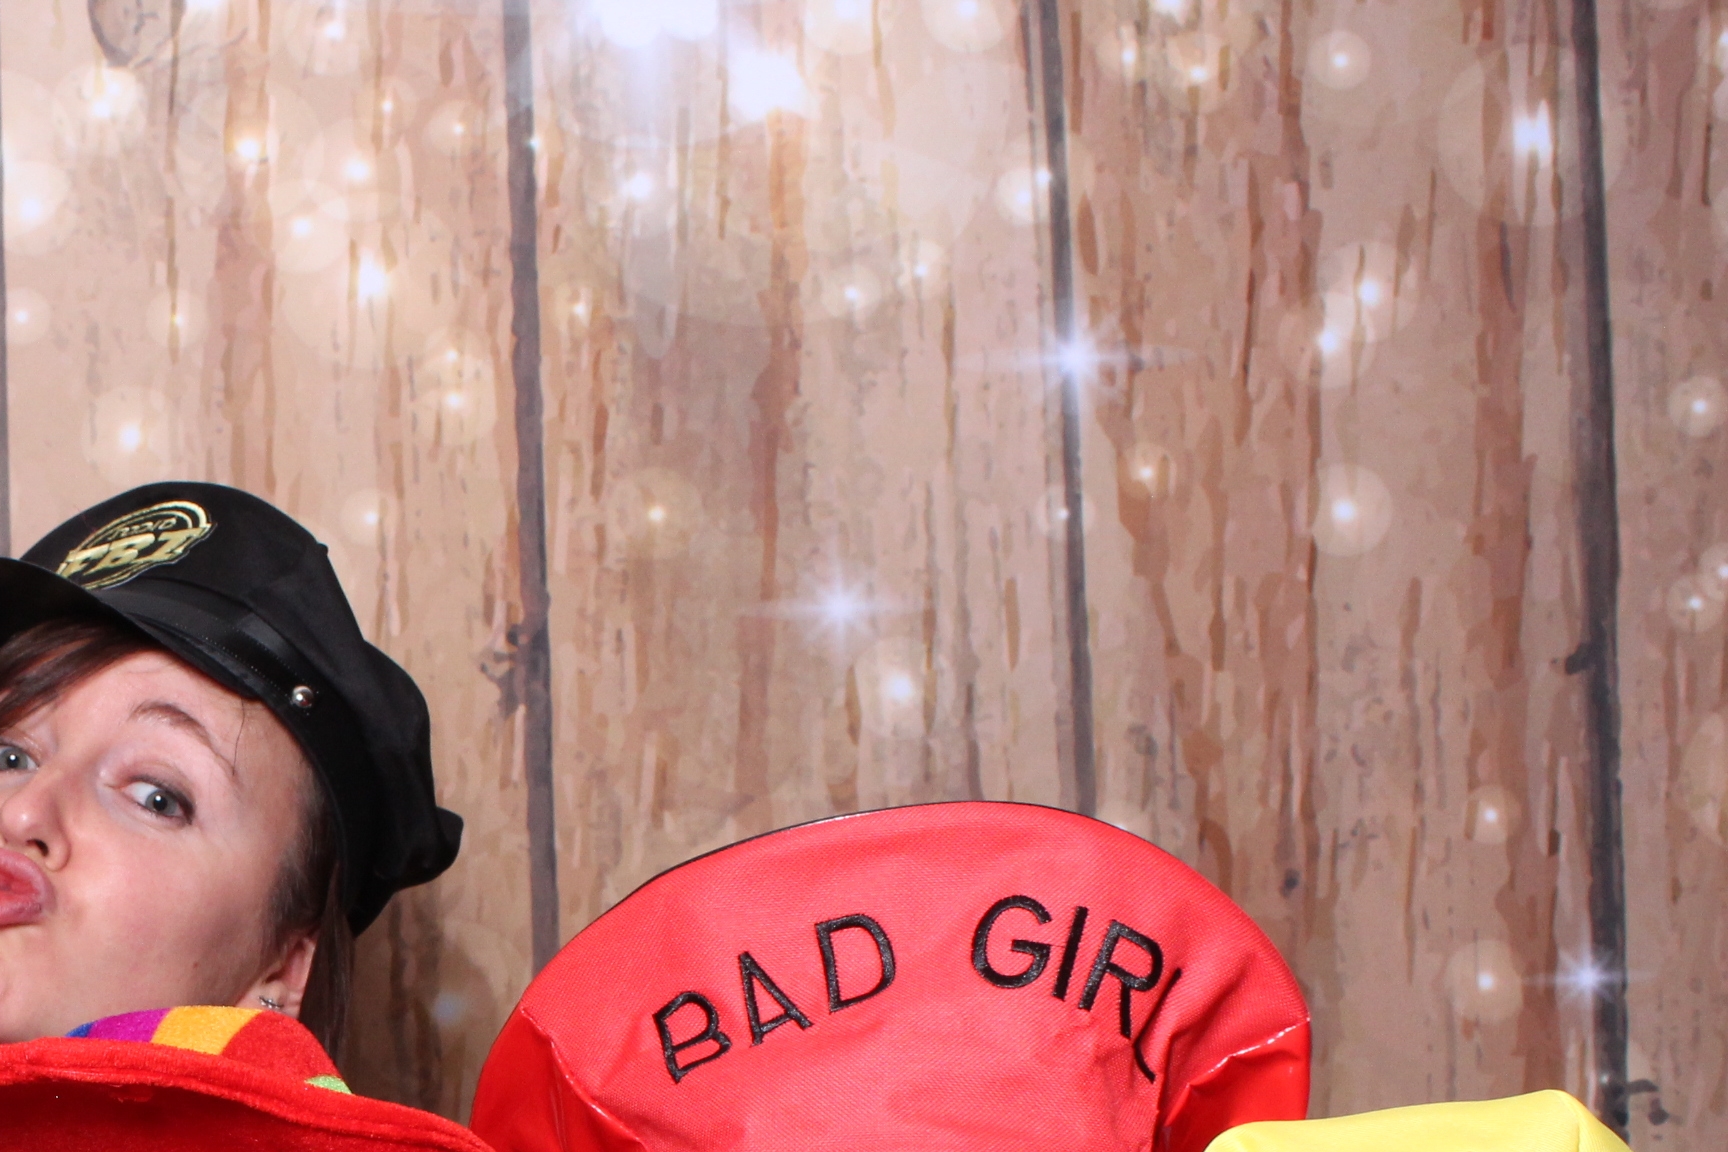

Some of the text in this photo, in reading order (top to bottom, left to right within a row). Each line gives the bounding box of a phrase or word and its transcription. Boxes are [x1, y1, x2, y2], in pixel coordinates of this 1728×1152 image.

[59, 528, 210, 578] FBI
[652, 895, 1183, 1085] BAD GIRL
